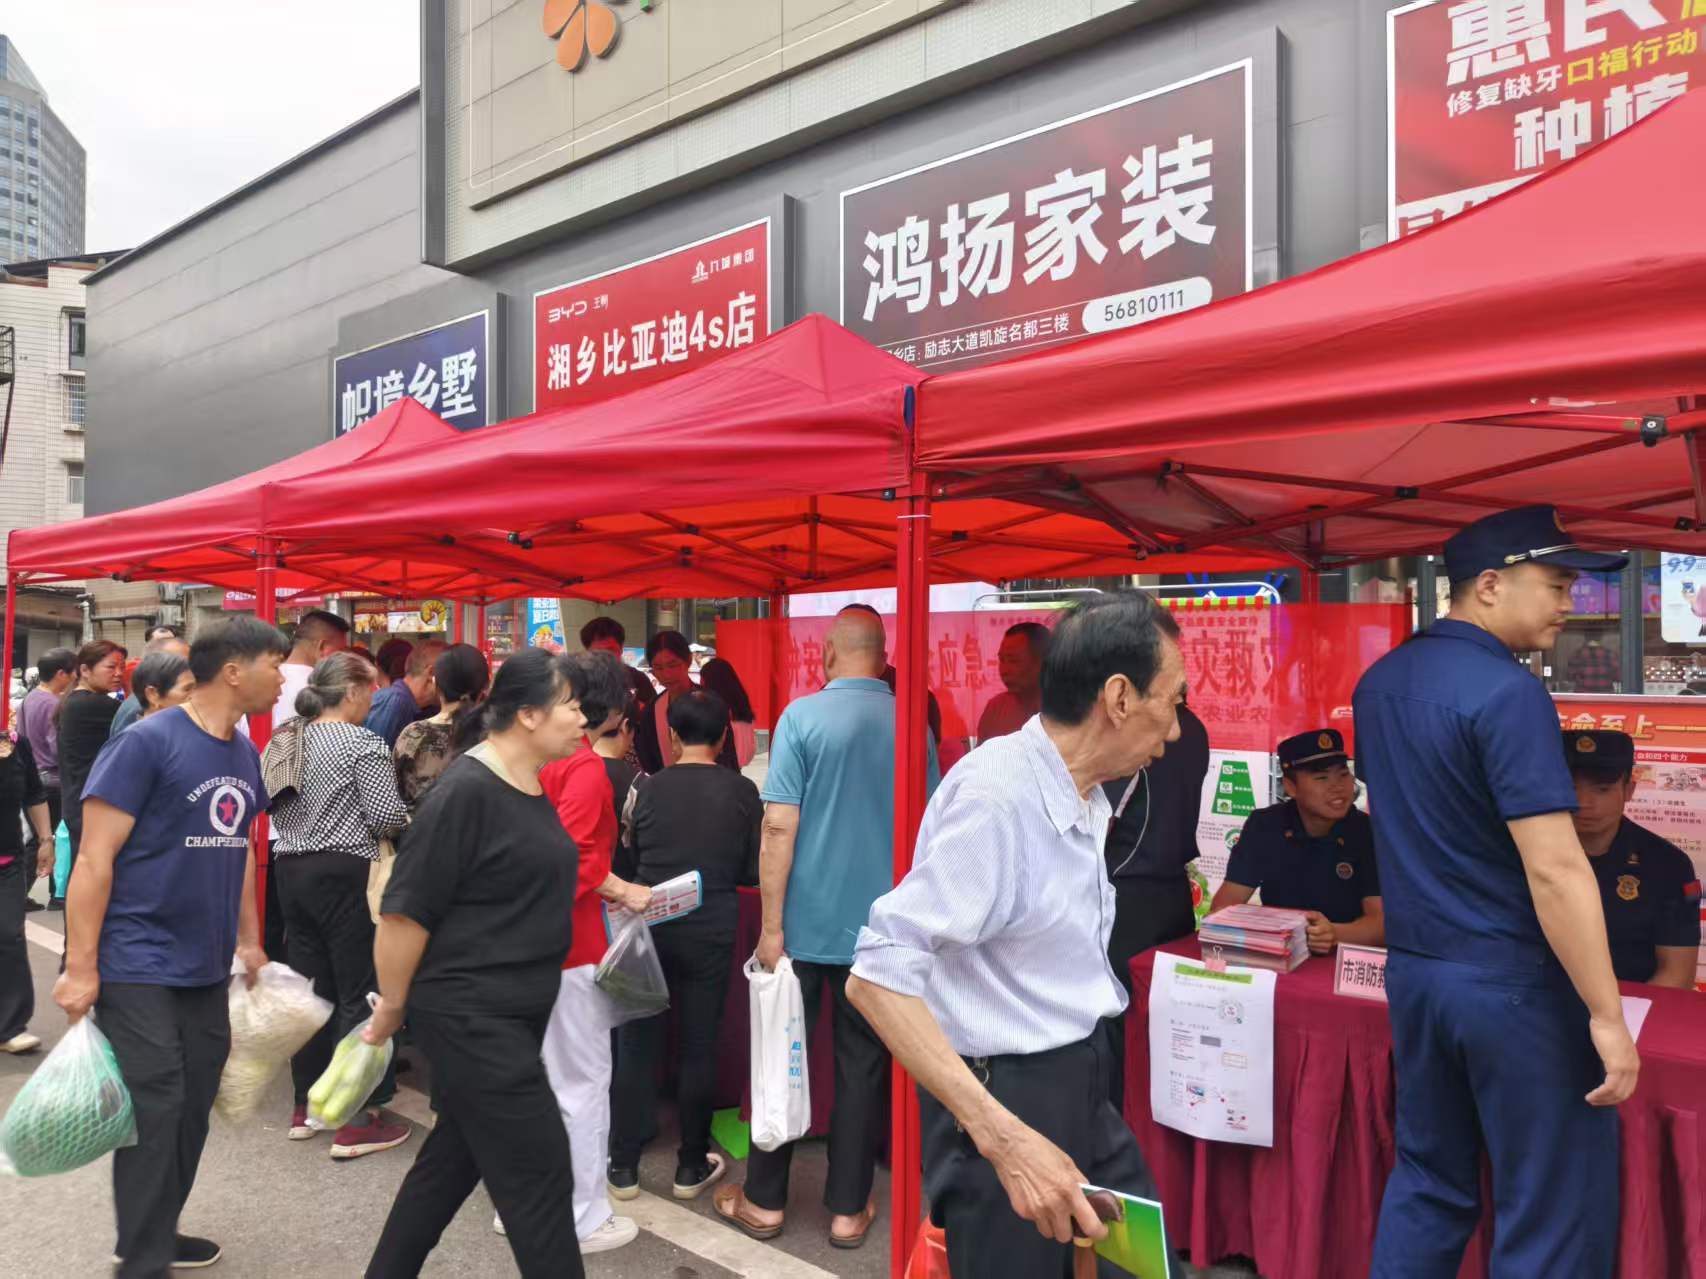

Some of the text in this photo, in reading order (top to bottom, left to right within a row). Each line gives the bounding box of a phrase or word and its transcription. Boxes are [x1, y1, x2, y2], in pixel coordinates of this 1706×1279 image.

[862, 134, 1216, 323] 鸿扬家装
[547, 291, 757, 390] 湘乡比亚迪4s店
[1104, 289, 1185, 322] 56810111
